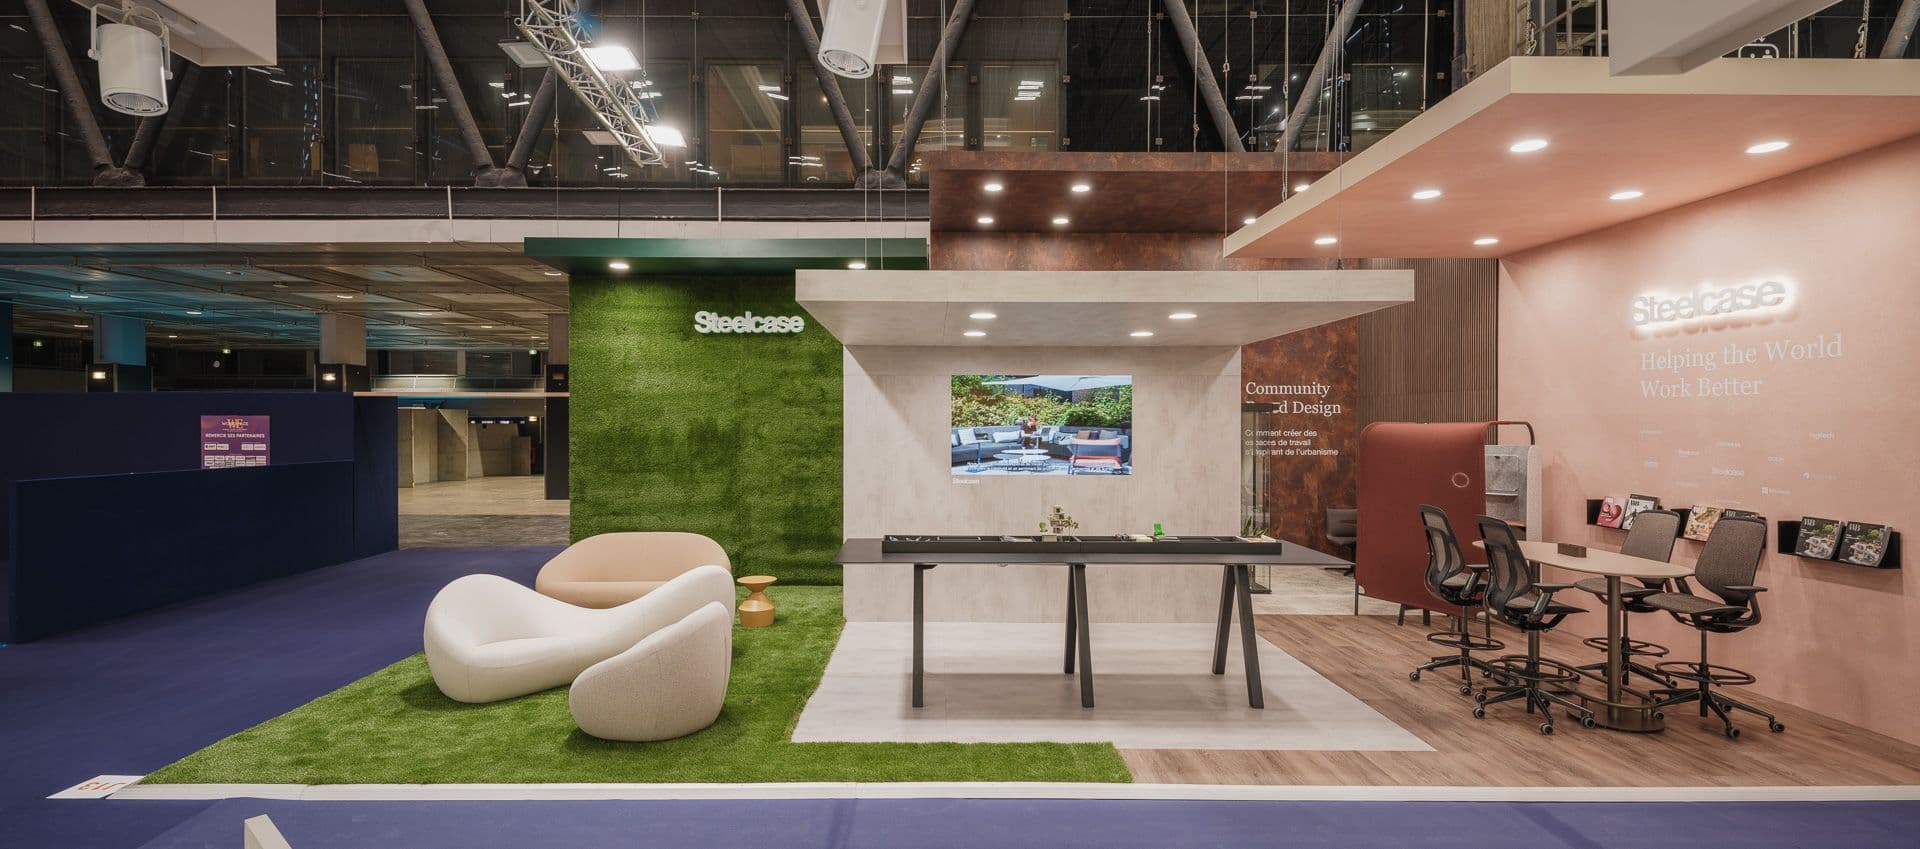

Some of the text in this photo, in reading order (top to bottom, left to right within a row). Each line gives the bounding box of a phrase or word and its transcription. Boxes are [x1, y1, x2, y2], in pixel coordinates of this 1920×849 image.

[1632, 280, 1787, 326] Steelcase
[694, 310, 805, 334] Steelcase
[1640, 333, 1843, 374] Helping the World
[1245, 381, 1331, 398] Community
[1640, 377, 1763, 399] Work Better
[1292, 400, 1342, 417] Design
[1283, 429, 1302, 437] créer
[1245, 439, 1277, 448] esaces
[1296, 448, 1339, 456] l'urbanisme
